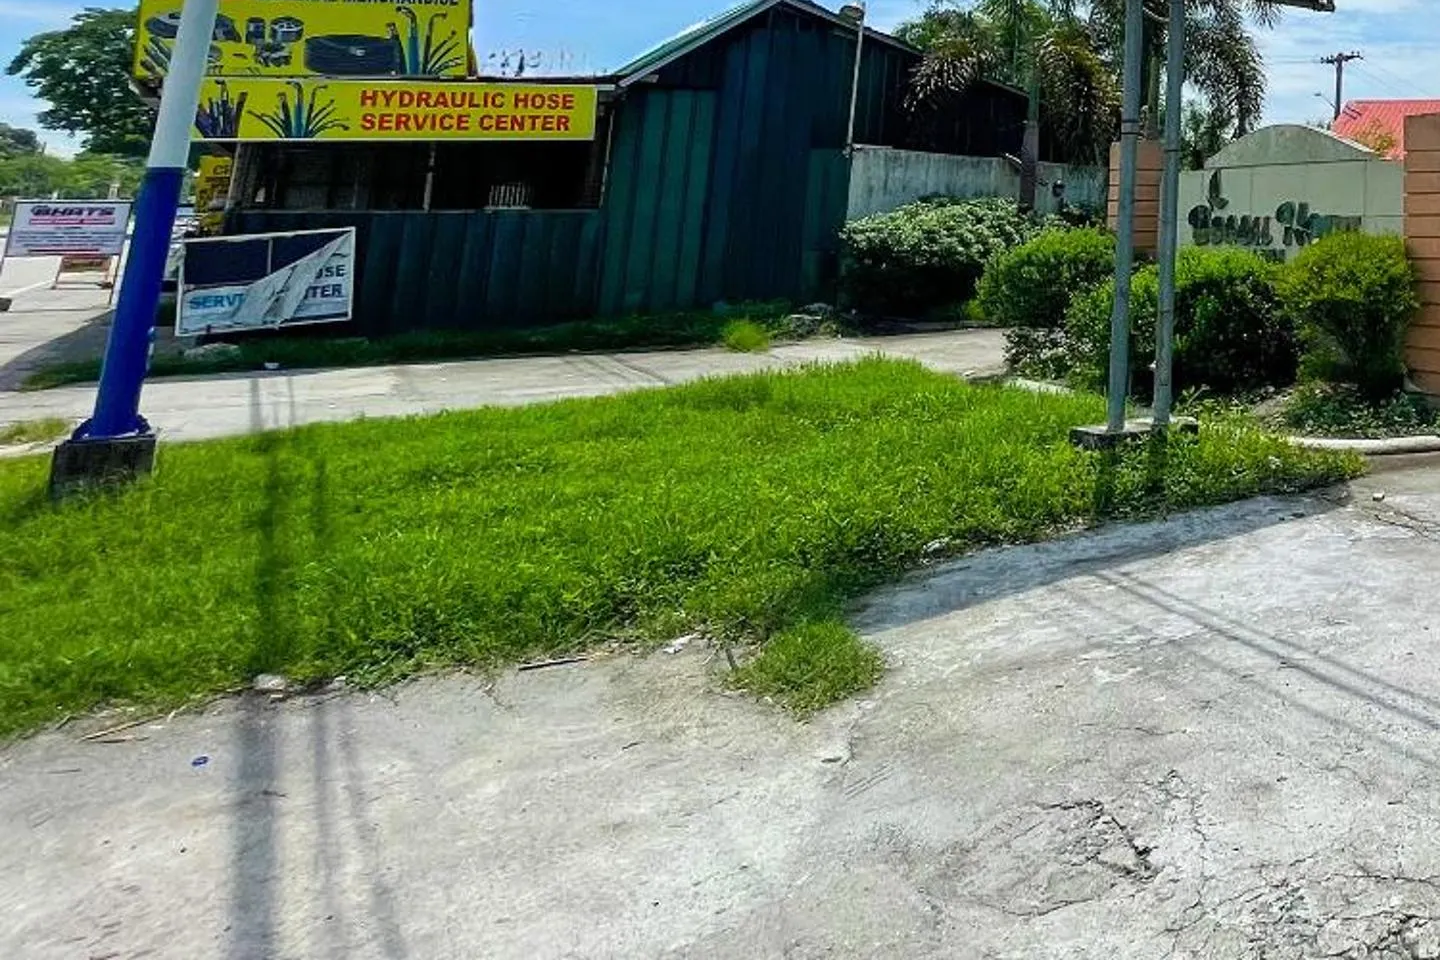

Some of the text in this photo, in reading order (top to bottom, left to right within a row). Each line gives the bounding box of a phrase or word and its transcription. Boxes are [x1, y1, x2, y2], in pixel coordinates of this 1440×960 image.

[360, 90, 575, 110] HYDRAULIC HOSE
[360, 113, 571, 131] SERVICE CENTER
